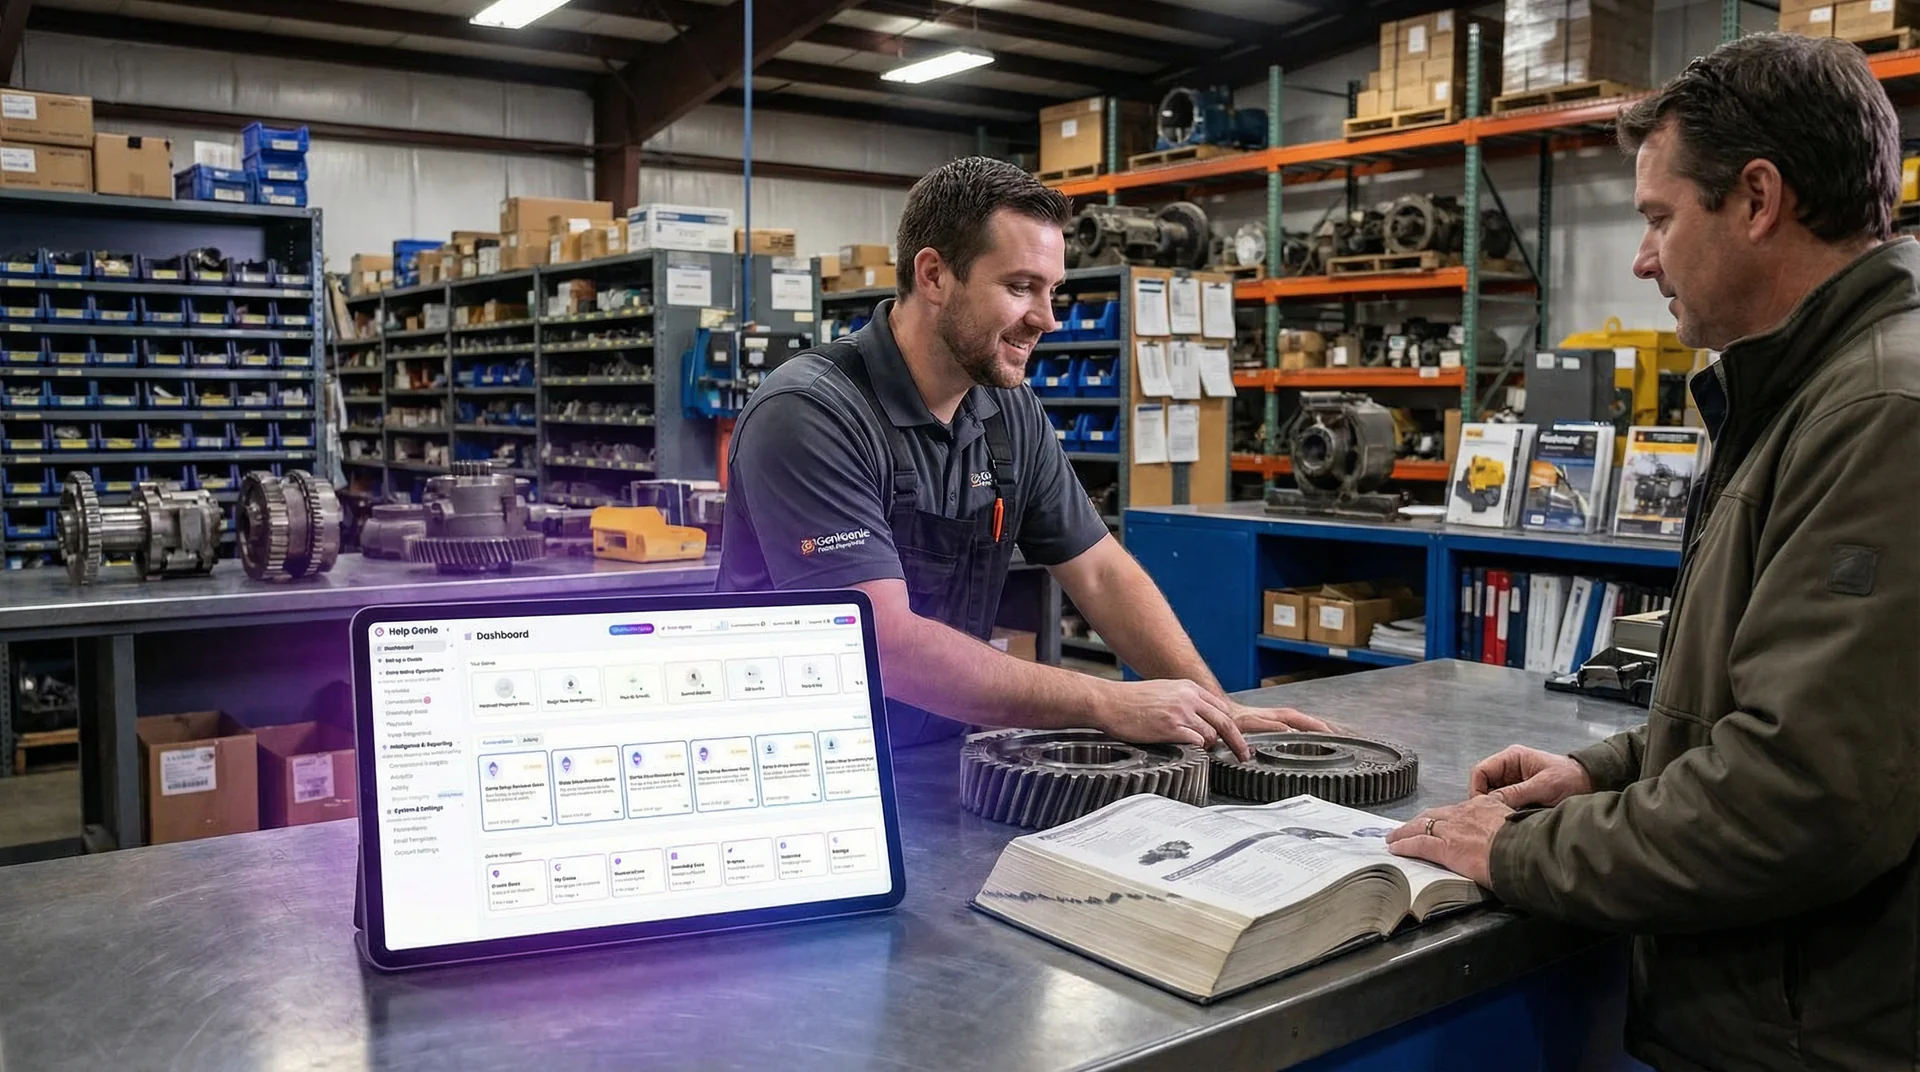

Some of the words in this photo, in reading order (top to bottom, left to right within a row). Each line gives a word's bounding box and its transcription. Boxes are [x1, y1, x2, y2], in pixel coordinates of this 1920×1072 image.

[389, 627, 410, 637] Help
[411, 625, 439, 635] Genie
[476, 630, 530, 640] Dashboard
